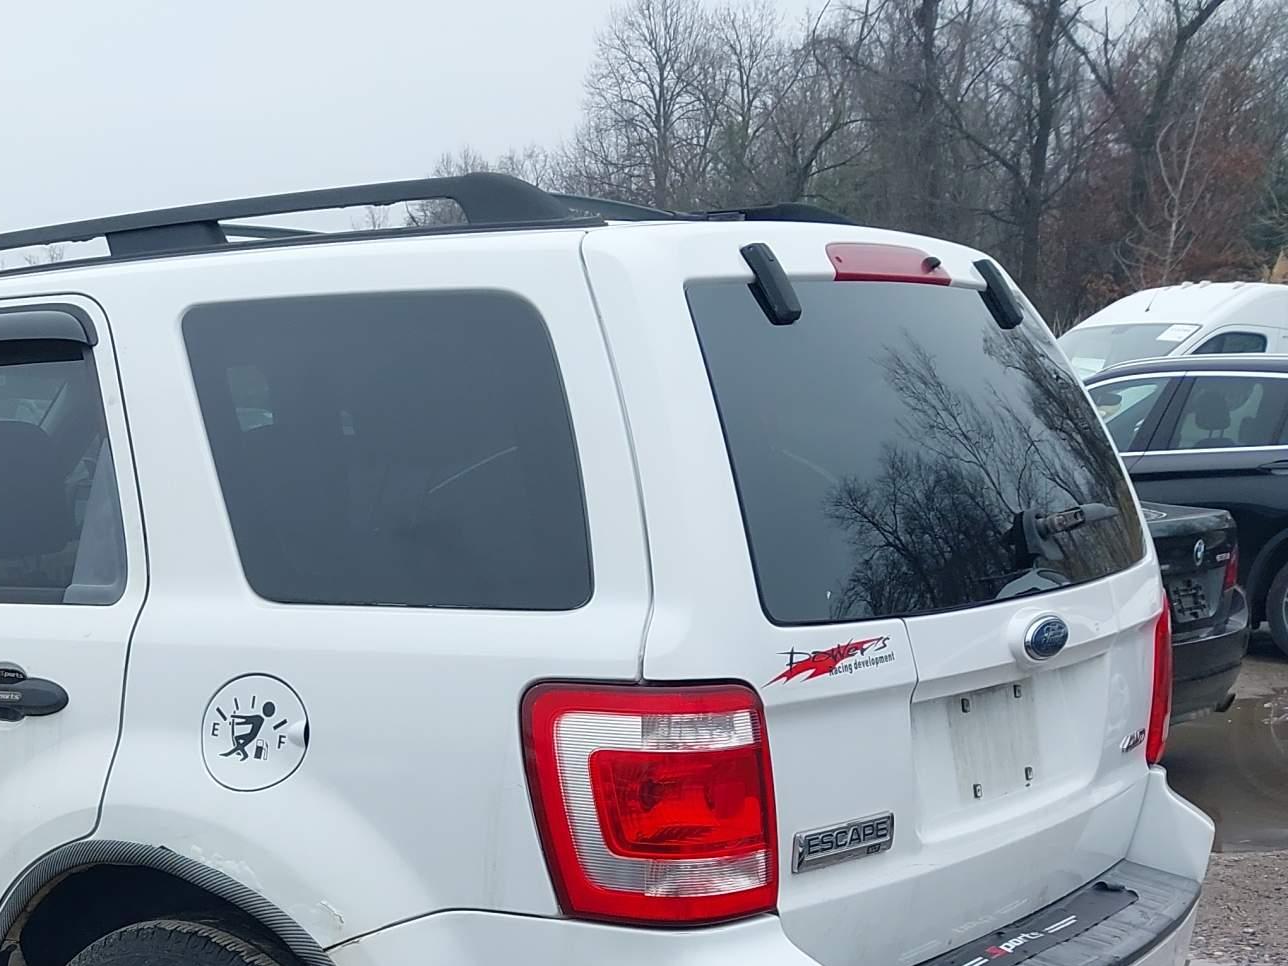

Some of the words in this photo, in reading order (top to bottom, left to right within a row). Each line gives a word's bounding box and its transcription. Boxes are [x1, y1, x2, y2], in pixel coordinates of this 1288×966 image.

[829, 664, 853, 677] Racing
[853, 651, 895, 670] development
[210, 722, 221, 737] E
[277, 734, 287, 749] F
[805, 820, 890, 855] ESCAPE
